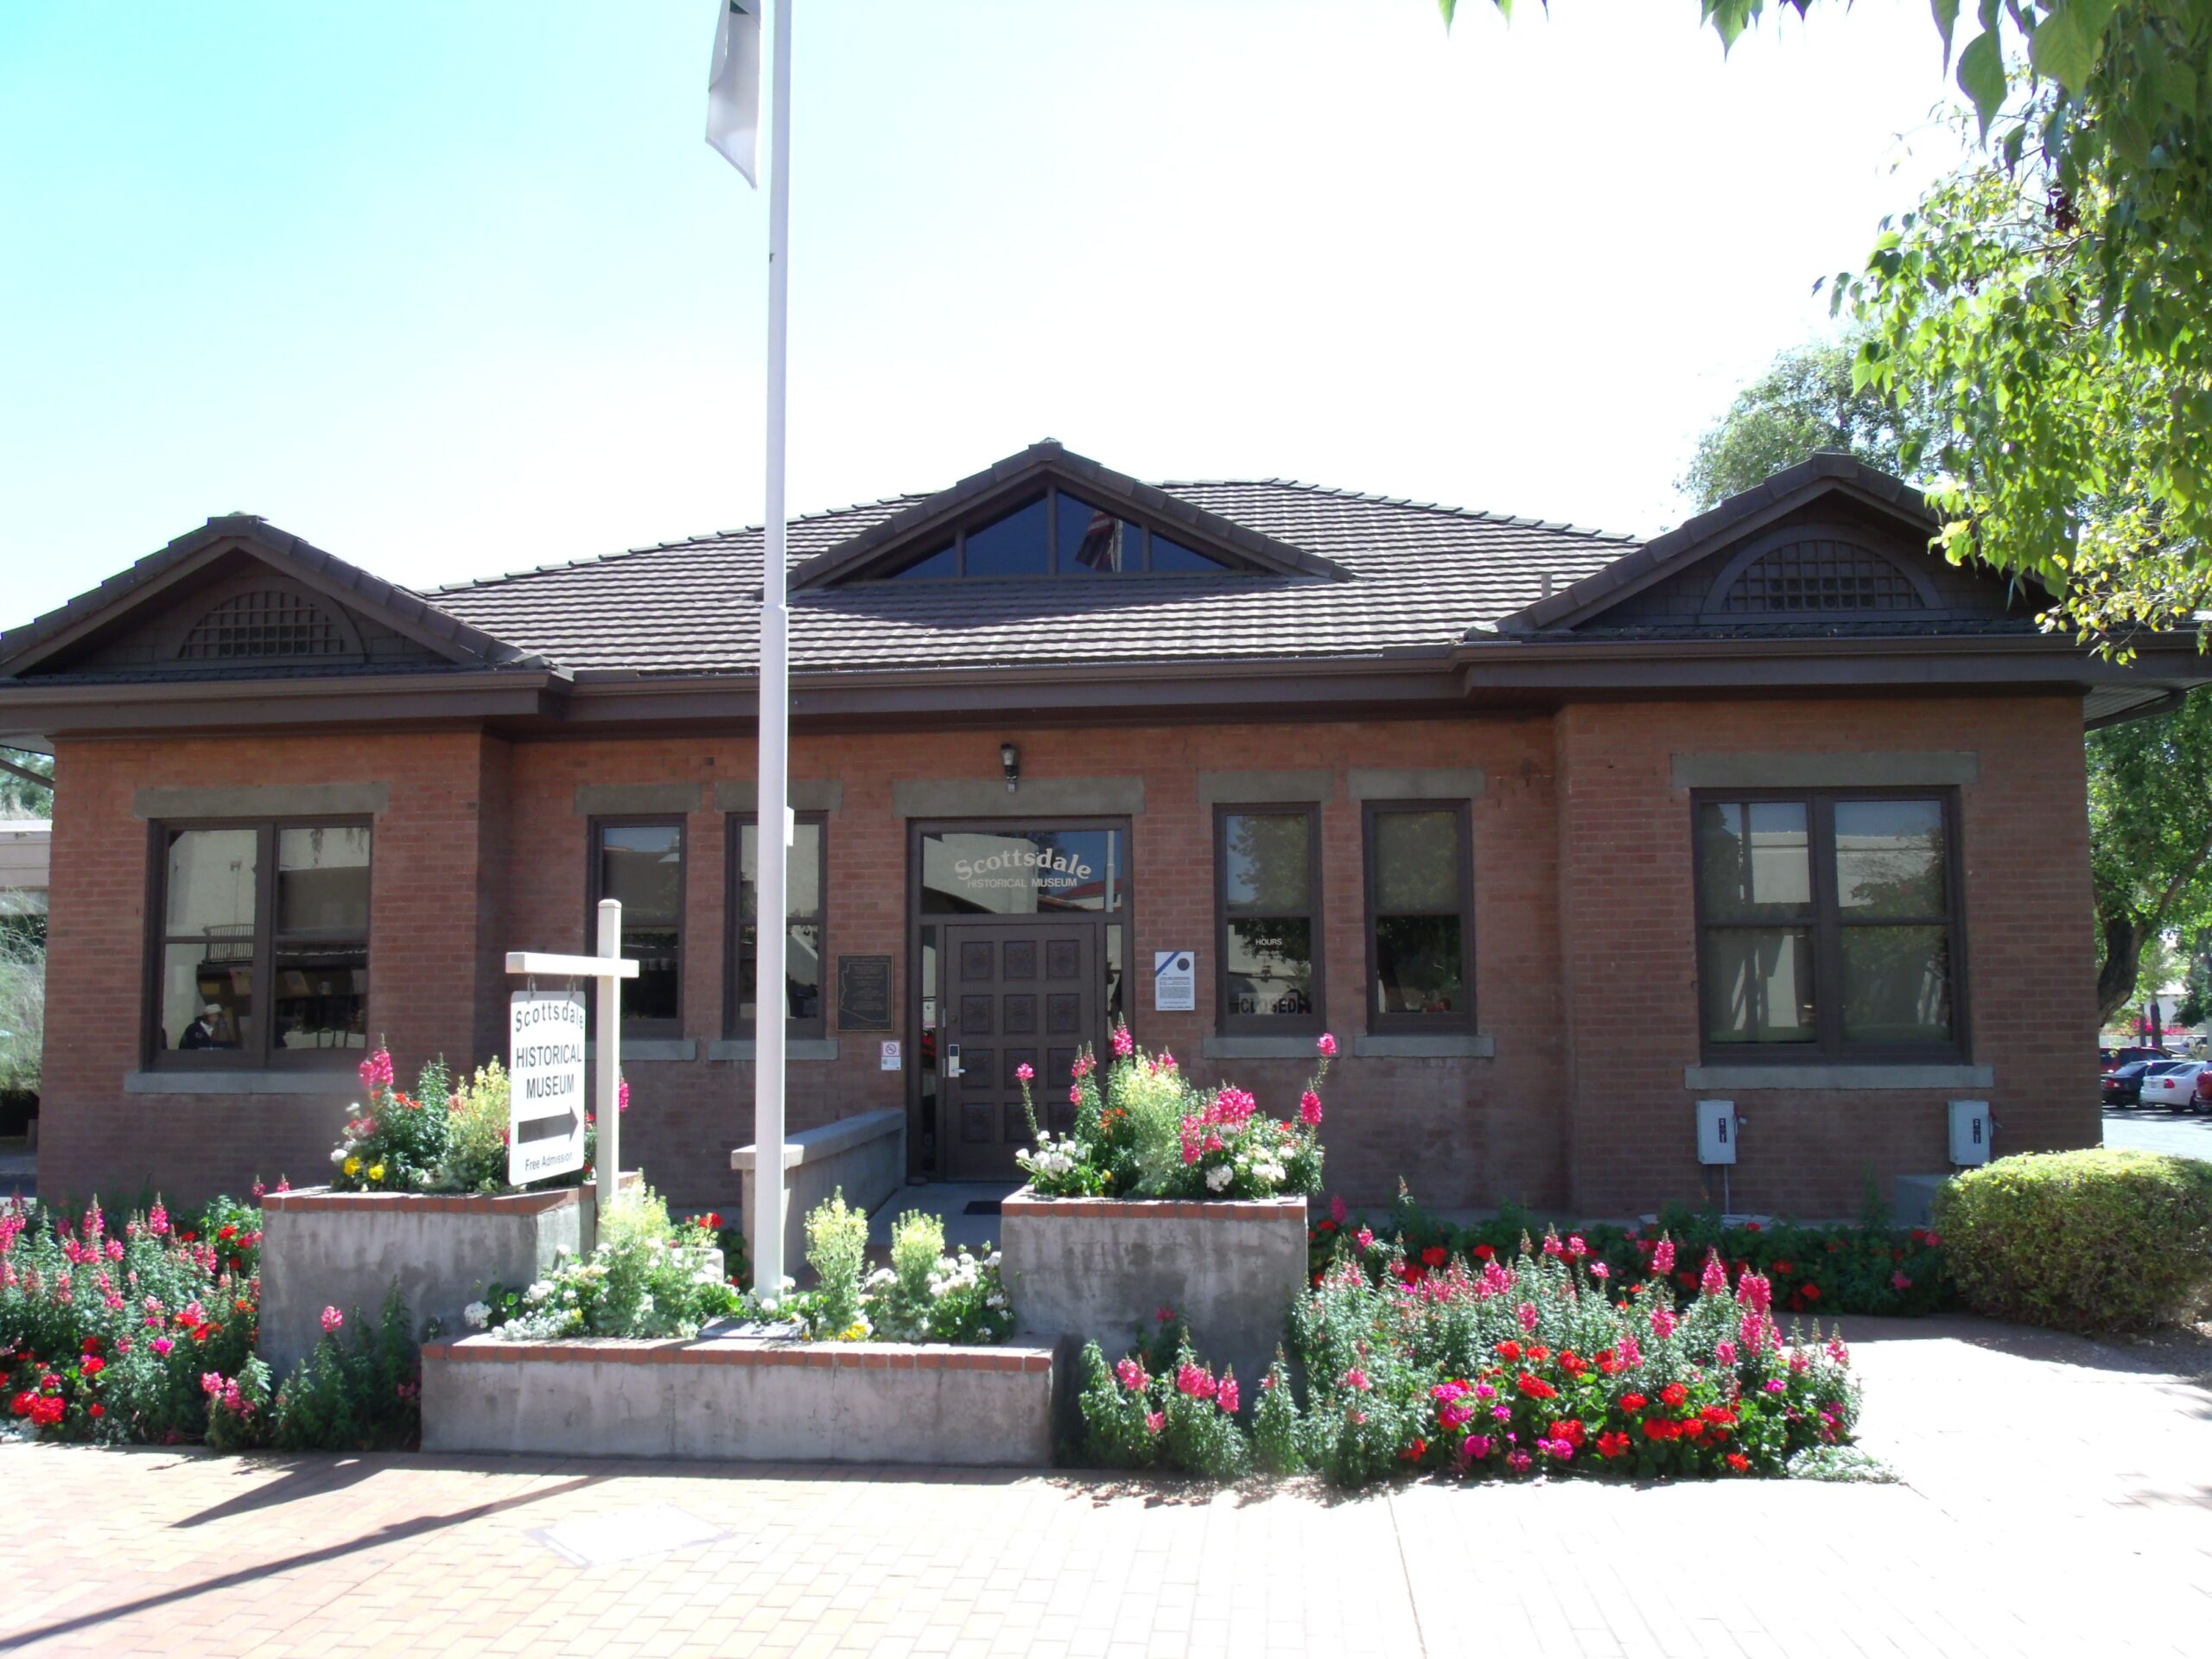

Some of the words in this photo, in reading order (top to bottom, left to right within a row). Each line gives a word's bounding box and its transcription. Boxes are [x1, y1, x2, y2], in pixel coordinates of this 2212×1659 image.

[955, 848, 1091, 880] Scottsdale
[967, 878, 1027, 888] HISTORICAL
[1032, 877, 1077, 887] MUSEUM
[516, 1001, 584, 1033] Scottsdale
[516, 1044, 582, 1069] HISTORICAL
[526, 1073, 575, 1099] MUSEUM
[525, 1158, 540, 1172] Free
[542, 1152, 573, 1167] Admission
